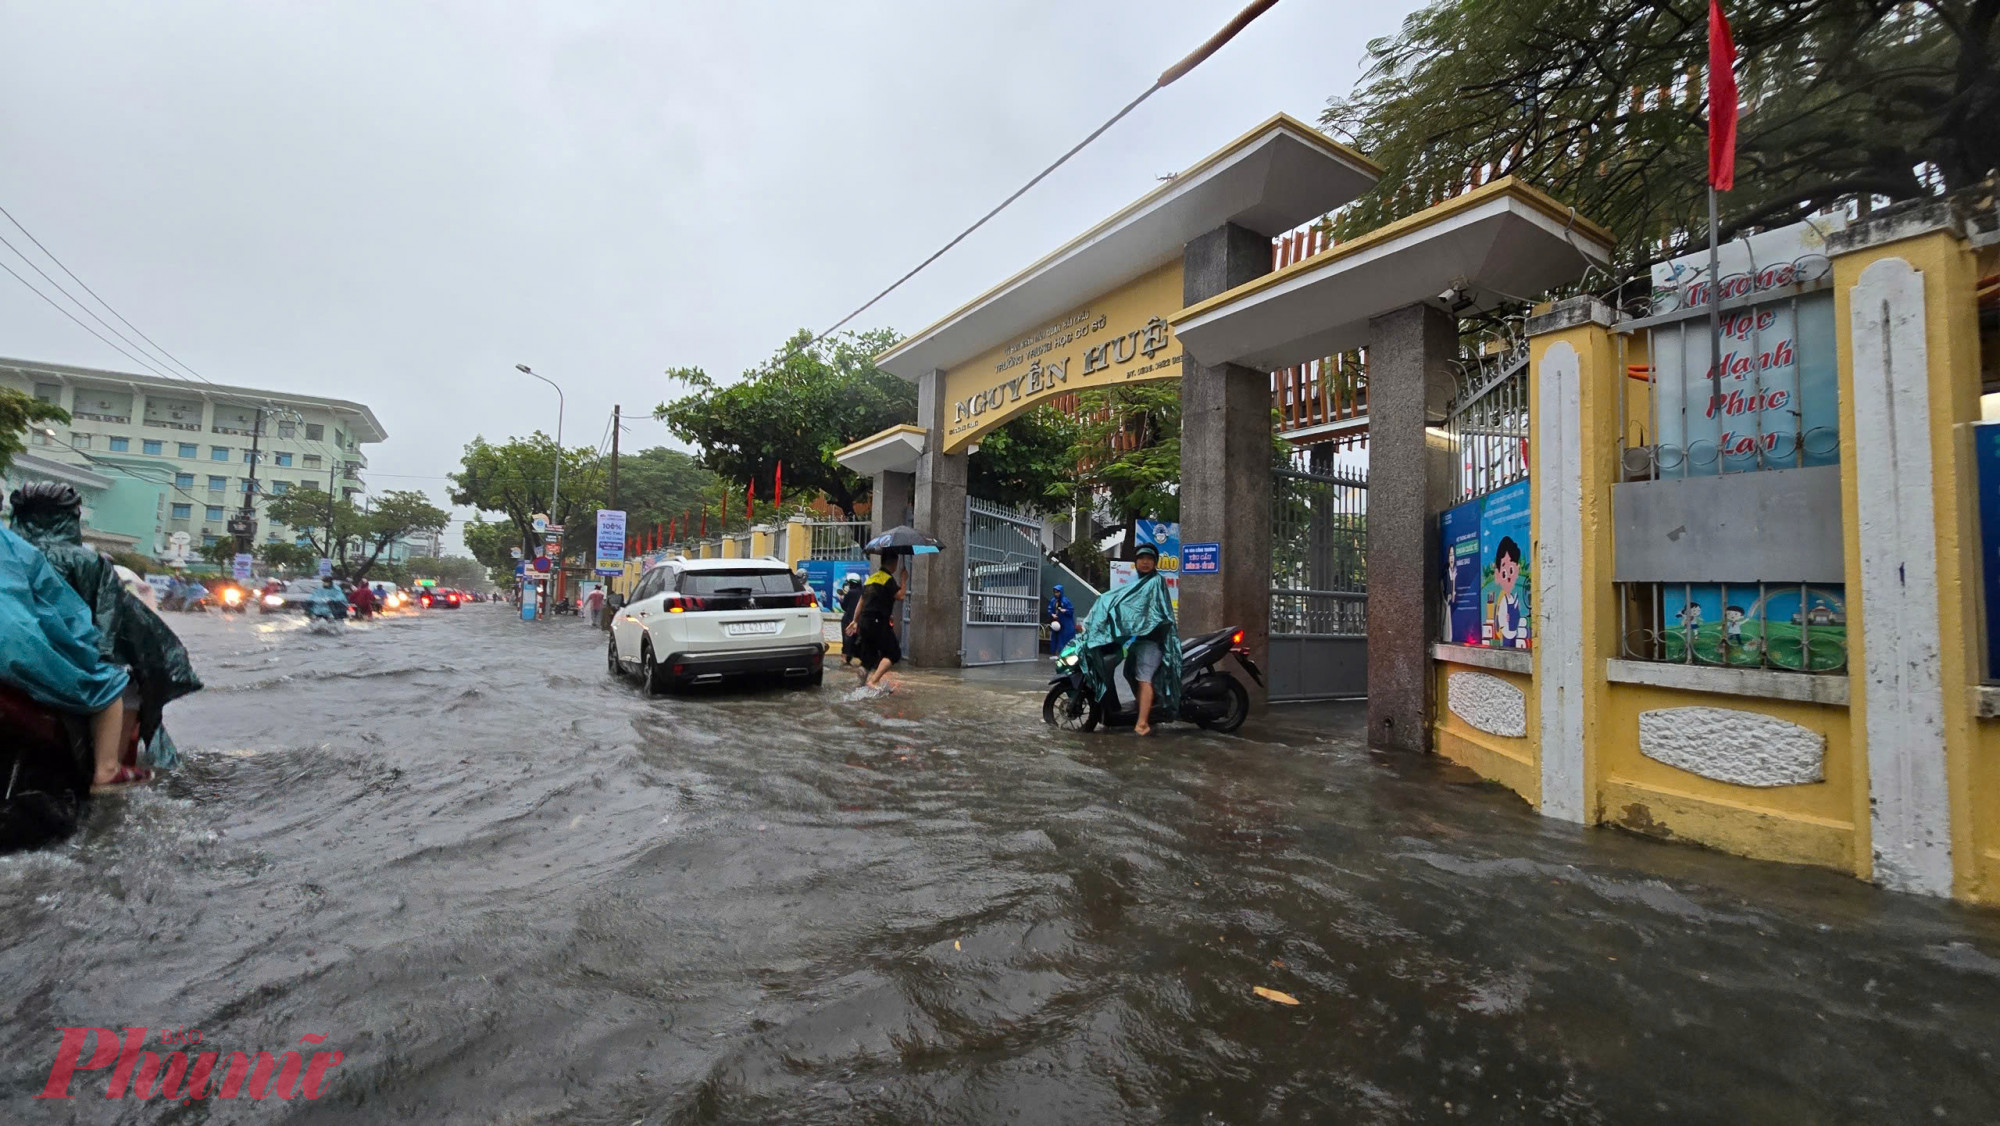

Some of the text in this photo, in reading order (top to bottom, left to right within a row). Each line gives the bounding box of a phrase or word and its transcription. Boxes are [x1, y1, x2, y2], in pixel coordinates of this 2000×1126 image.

[1026, 341, 1053, 361] TRUNG
[1054, 332, 1074, 348] HỌC
[1074, 323, 1089, 340] CƠ
[1091, 313, 1107, 333] SỞ
[1718, 311, 1776, 340] Học
[954, 314, 1169, 424] NGUYỄN HUỆ
[1706, 339, 1796, 381] Hạnh
[1705, 387, 1790, 420] Phúc
[1721, 431, 1779, 456] Lan
